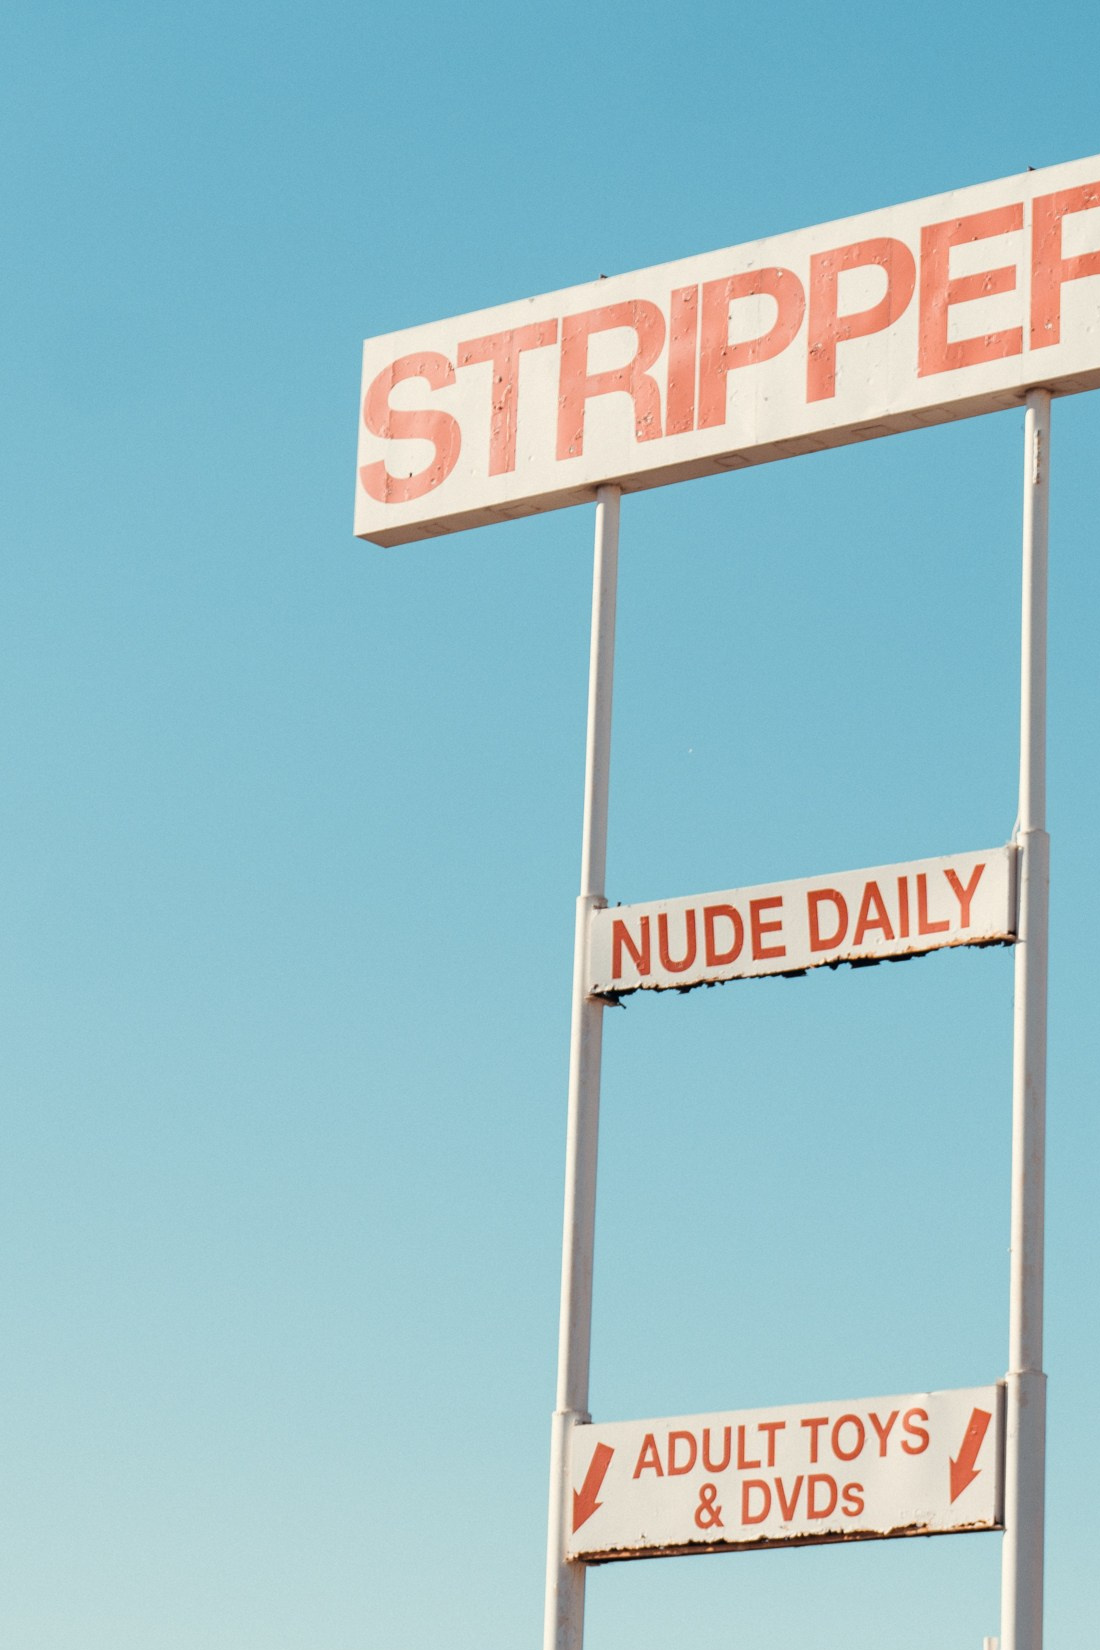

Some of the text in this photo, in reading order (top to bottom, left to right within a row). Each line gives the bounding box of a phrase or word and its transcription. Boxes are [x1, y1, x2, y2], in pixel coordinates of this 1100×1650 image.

[611, 863, 987, 980] NUDE DAILY
[632, 1406, 931, 1480] ADULT TOYS
[693, 1472, 866, 1530] & DVDs
